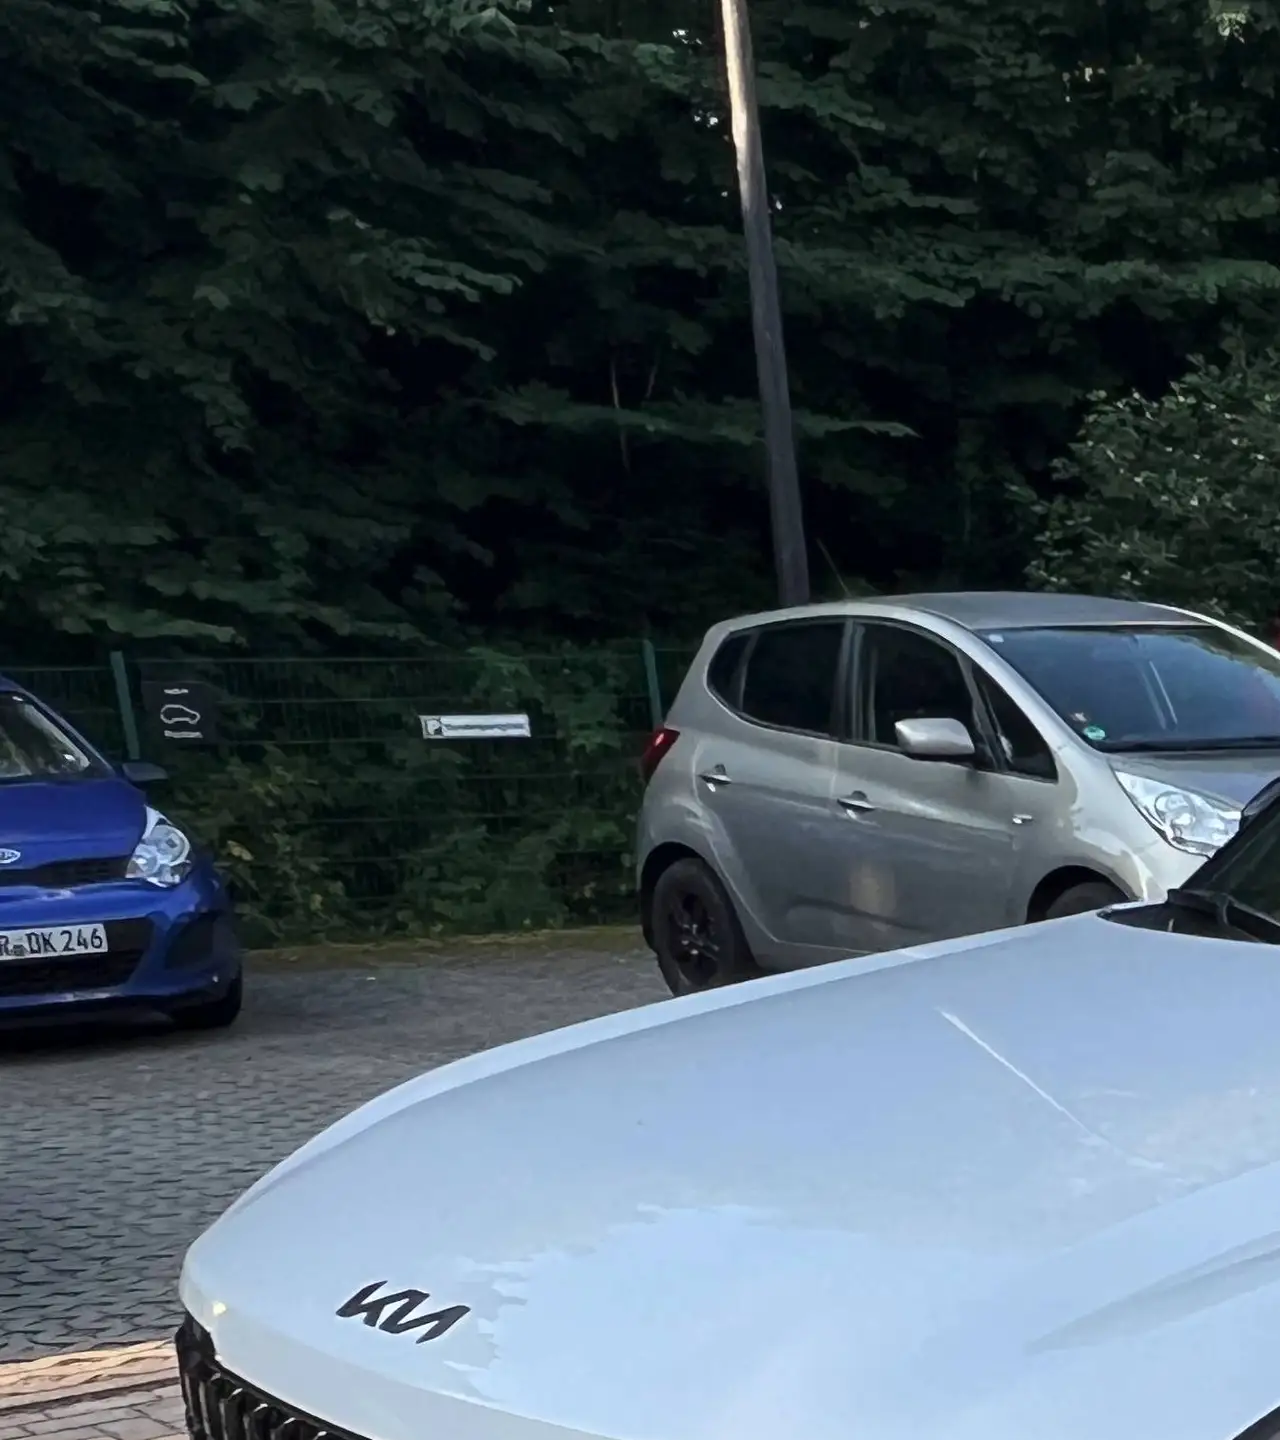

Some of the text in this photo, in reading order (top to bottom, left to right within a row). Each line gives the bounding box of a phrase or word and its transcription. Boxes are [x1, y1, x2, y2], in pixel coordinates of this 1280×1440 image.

[25, 932, 57, 953] DK
[61, 928, 103, 951] 246
[335, 1280, 471, 1345] KIA
